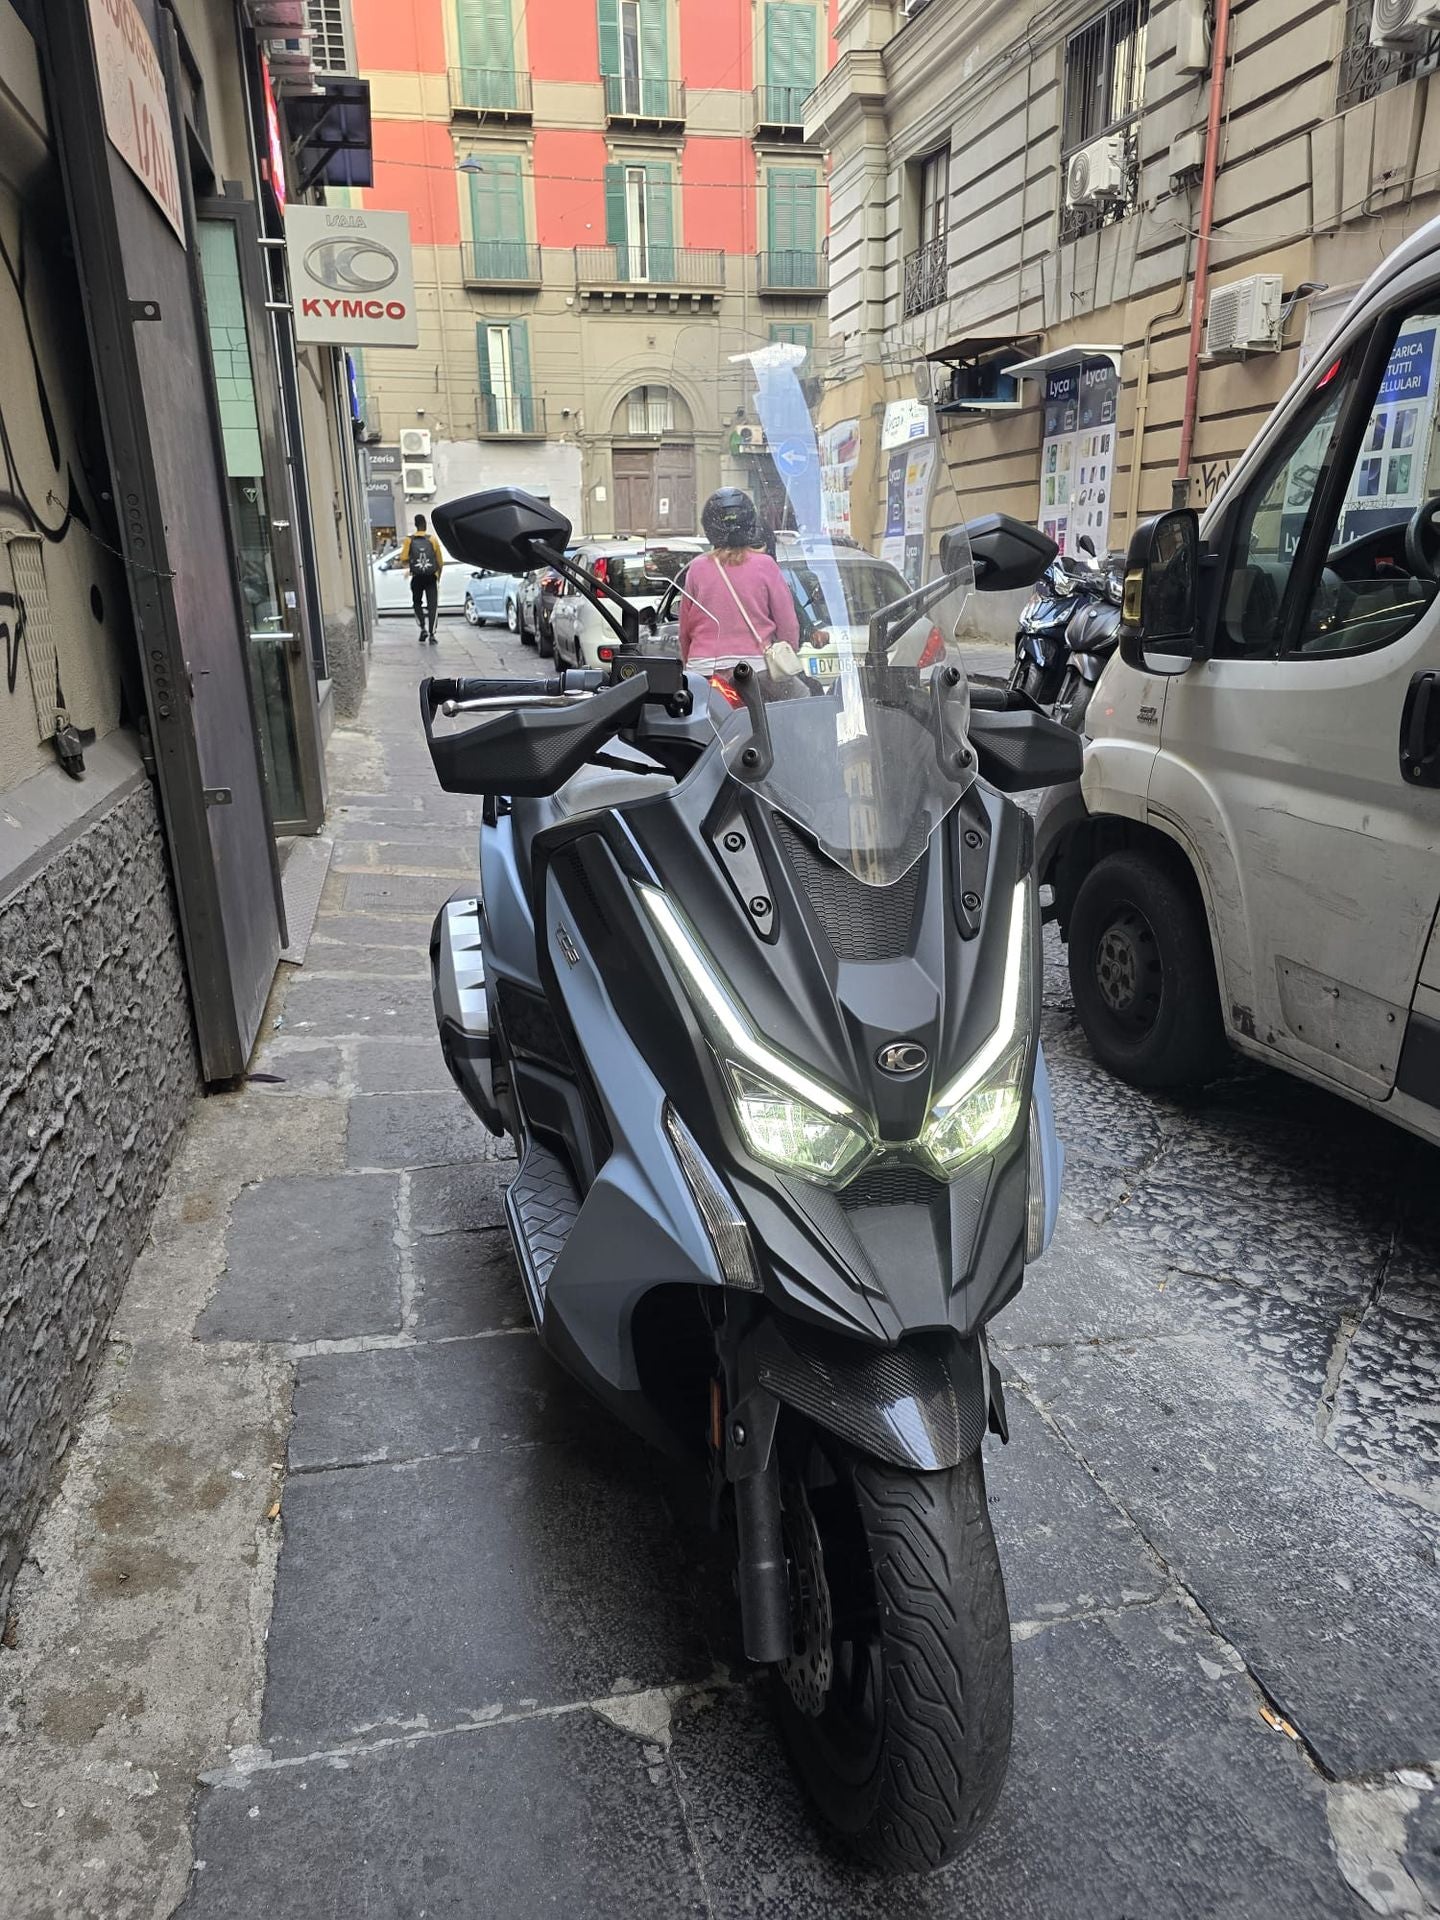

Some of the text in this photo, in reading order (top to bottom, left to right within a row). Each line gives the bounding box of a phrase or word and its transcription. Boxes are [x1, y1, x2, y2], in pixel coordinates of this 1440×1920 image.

[302, 298, 406, 320] KYMCO
[1085, 368, 1108, 387] Lyca
[1387, 361, 1412, 377] TUTTI
[1050, 379, 1070, 397] Lyca
[1379, 376, 1421, 393] ELLULARI
